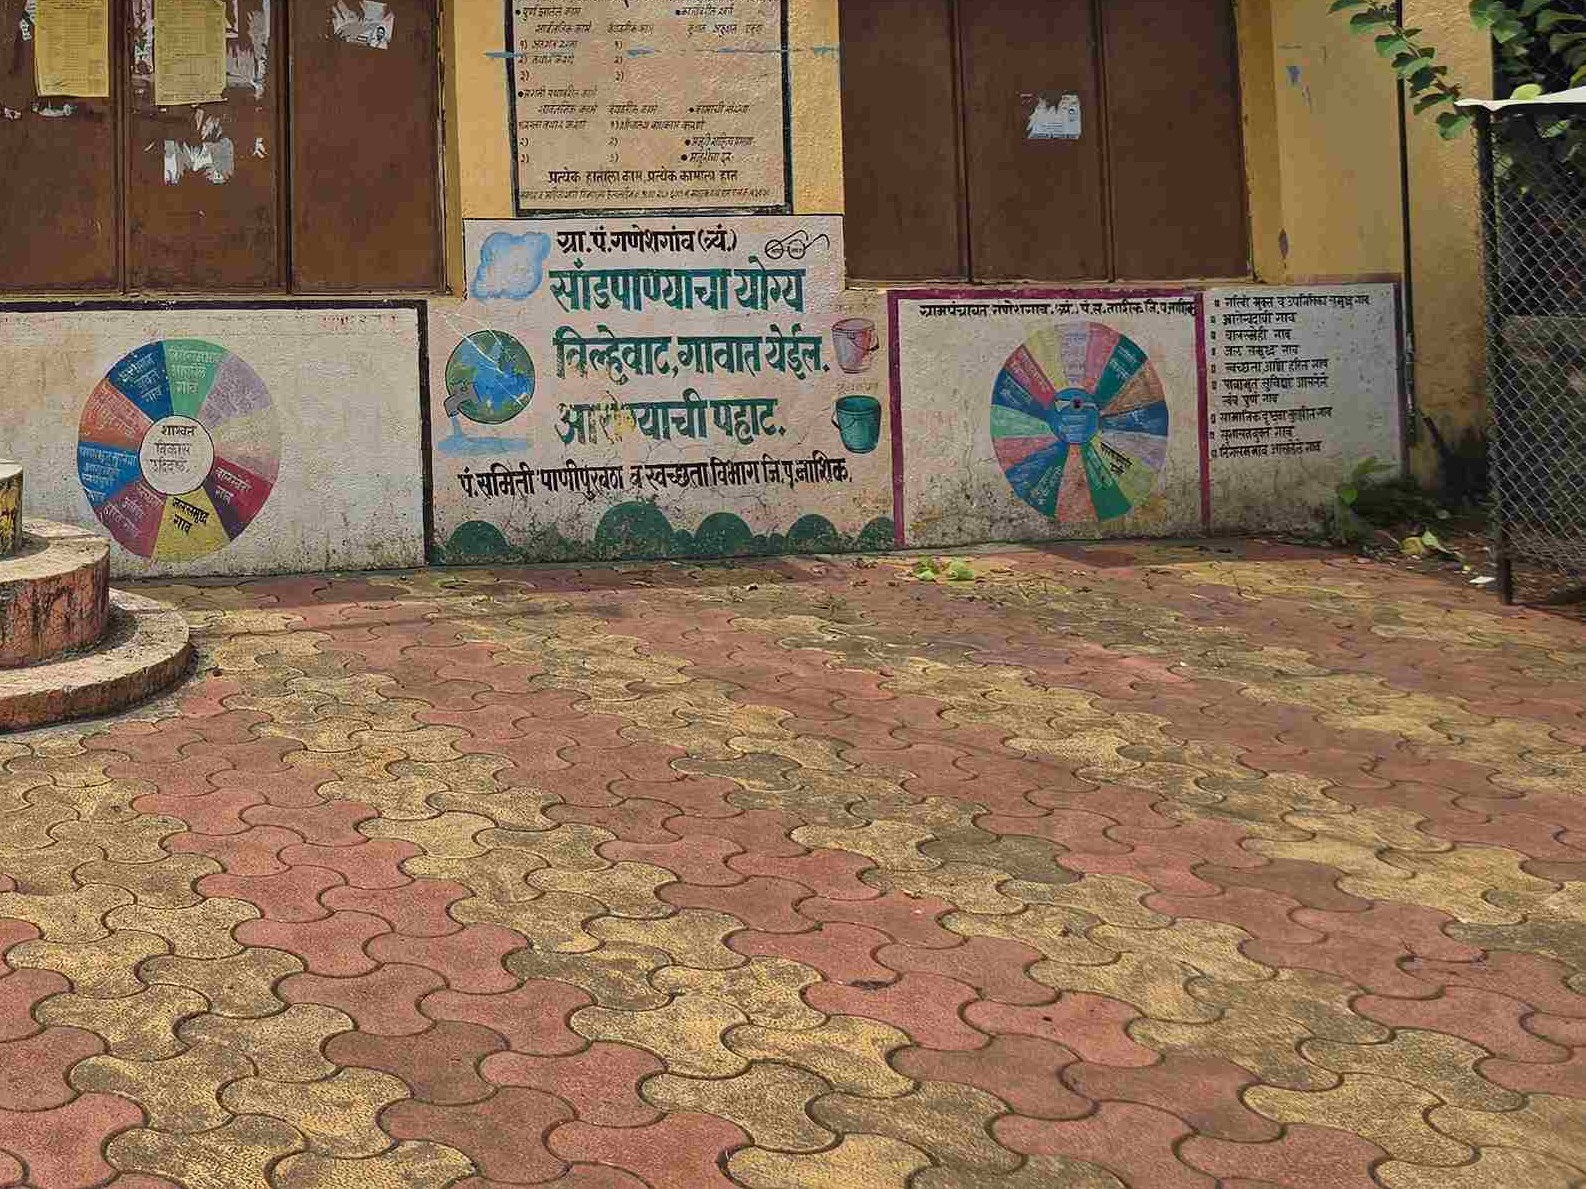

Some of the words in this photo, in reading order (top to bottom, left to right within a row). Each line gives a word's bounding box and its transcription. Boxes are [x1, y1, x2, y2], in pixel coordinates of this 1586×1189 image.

[733, 255, 807, 312] योग्य
[678, 336, 763, 379] गावात
[764, 323, 831, 380] येईल.
[713, 398, 787, 446] पहाट.
